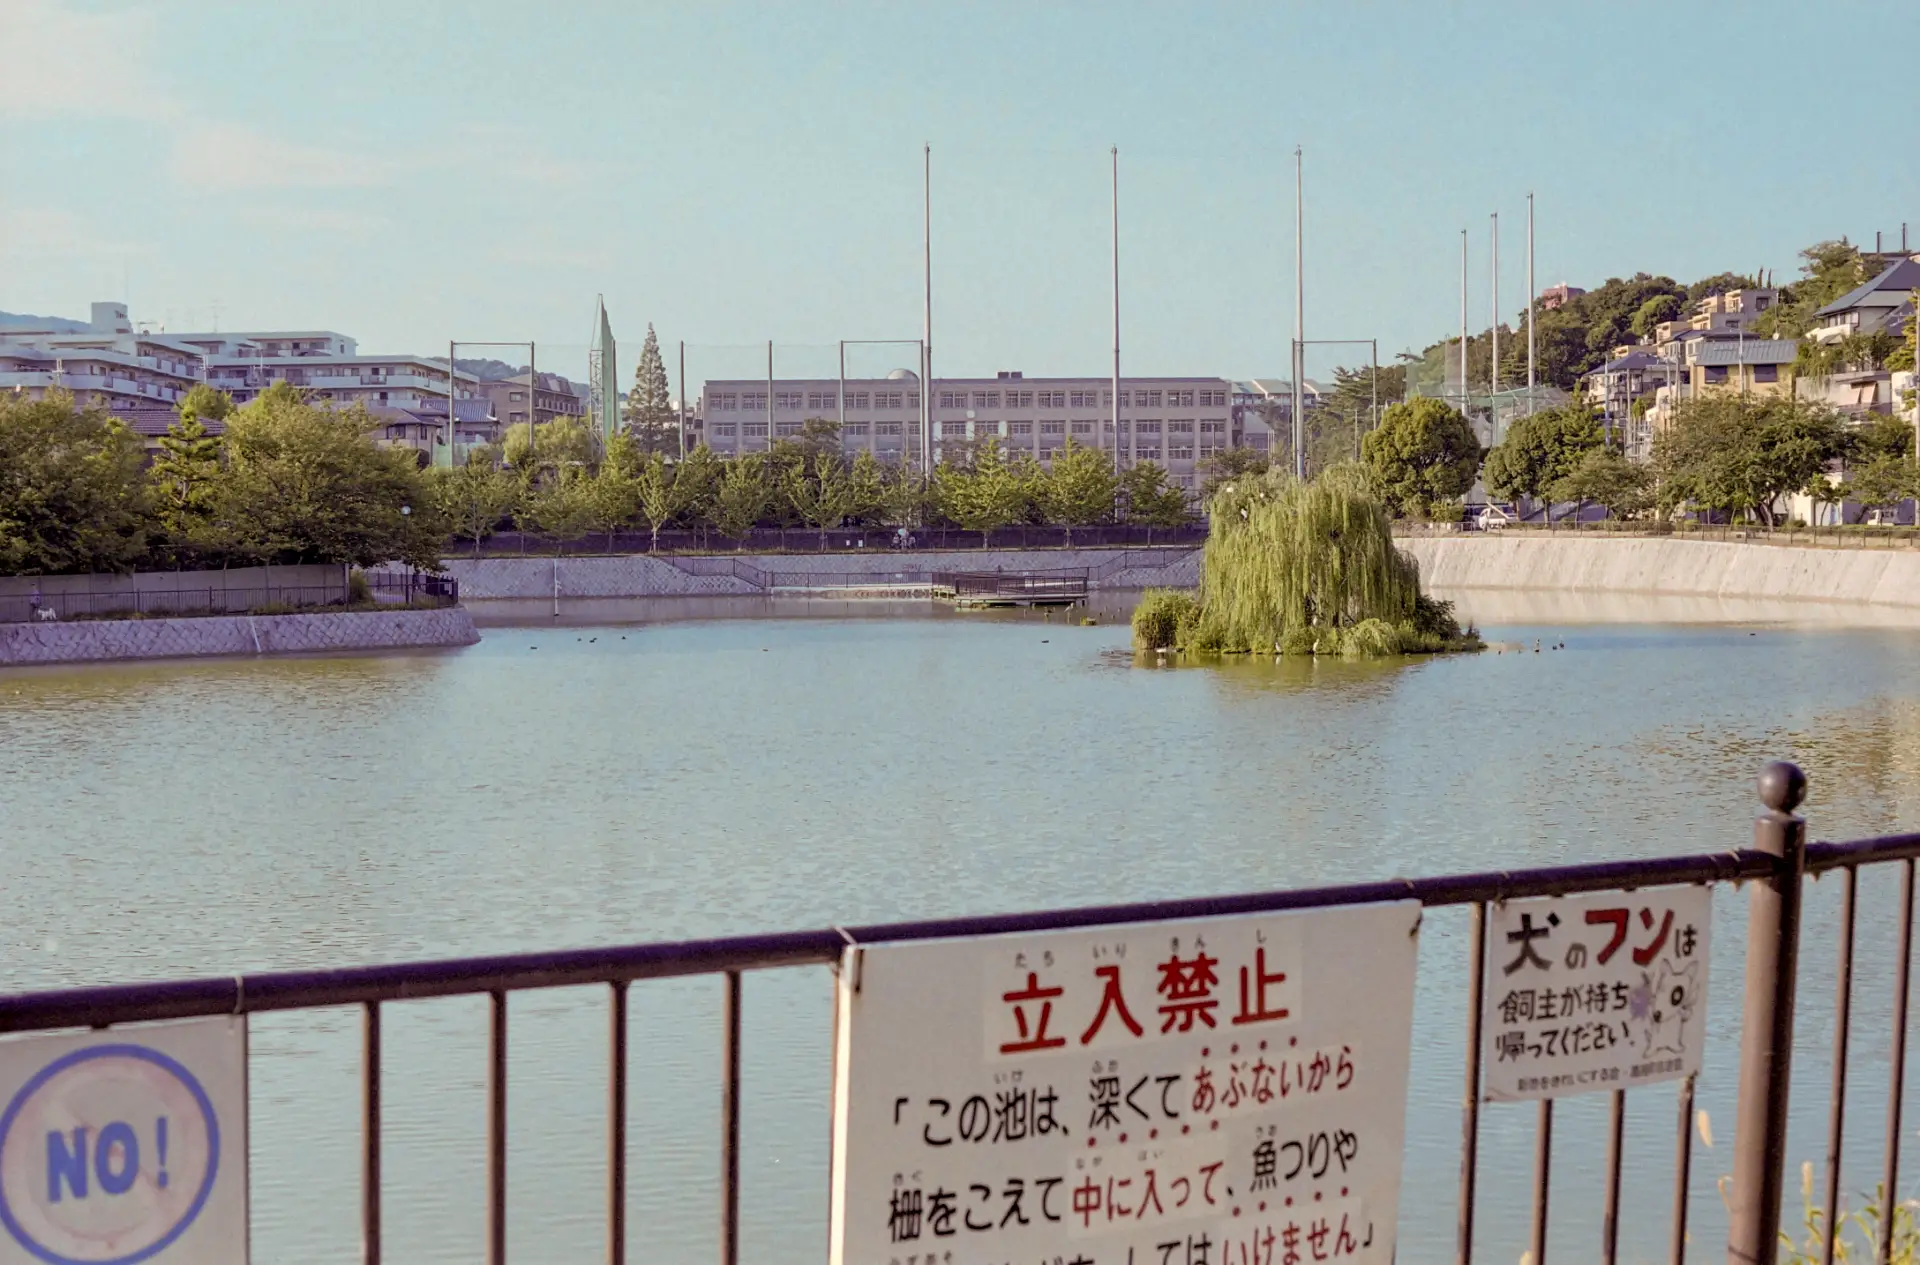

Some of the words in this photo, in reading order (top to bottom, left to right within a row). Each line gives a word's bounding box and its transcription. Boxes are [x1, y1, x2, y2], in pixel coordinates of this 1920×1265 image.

[1502, 906, 1698, 976] 犬のフンは
[999, 947, 1290, 1053] 立入禁止
[1498, 982, 1630, 1024] 飼主が持ち
[46, 1115, 169, 1203] NO!
